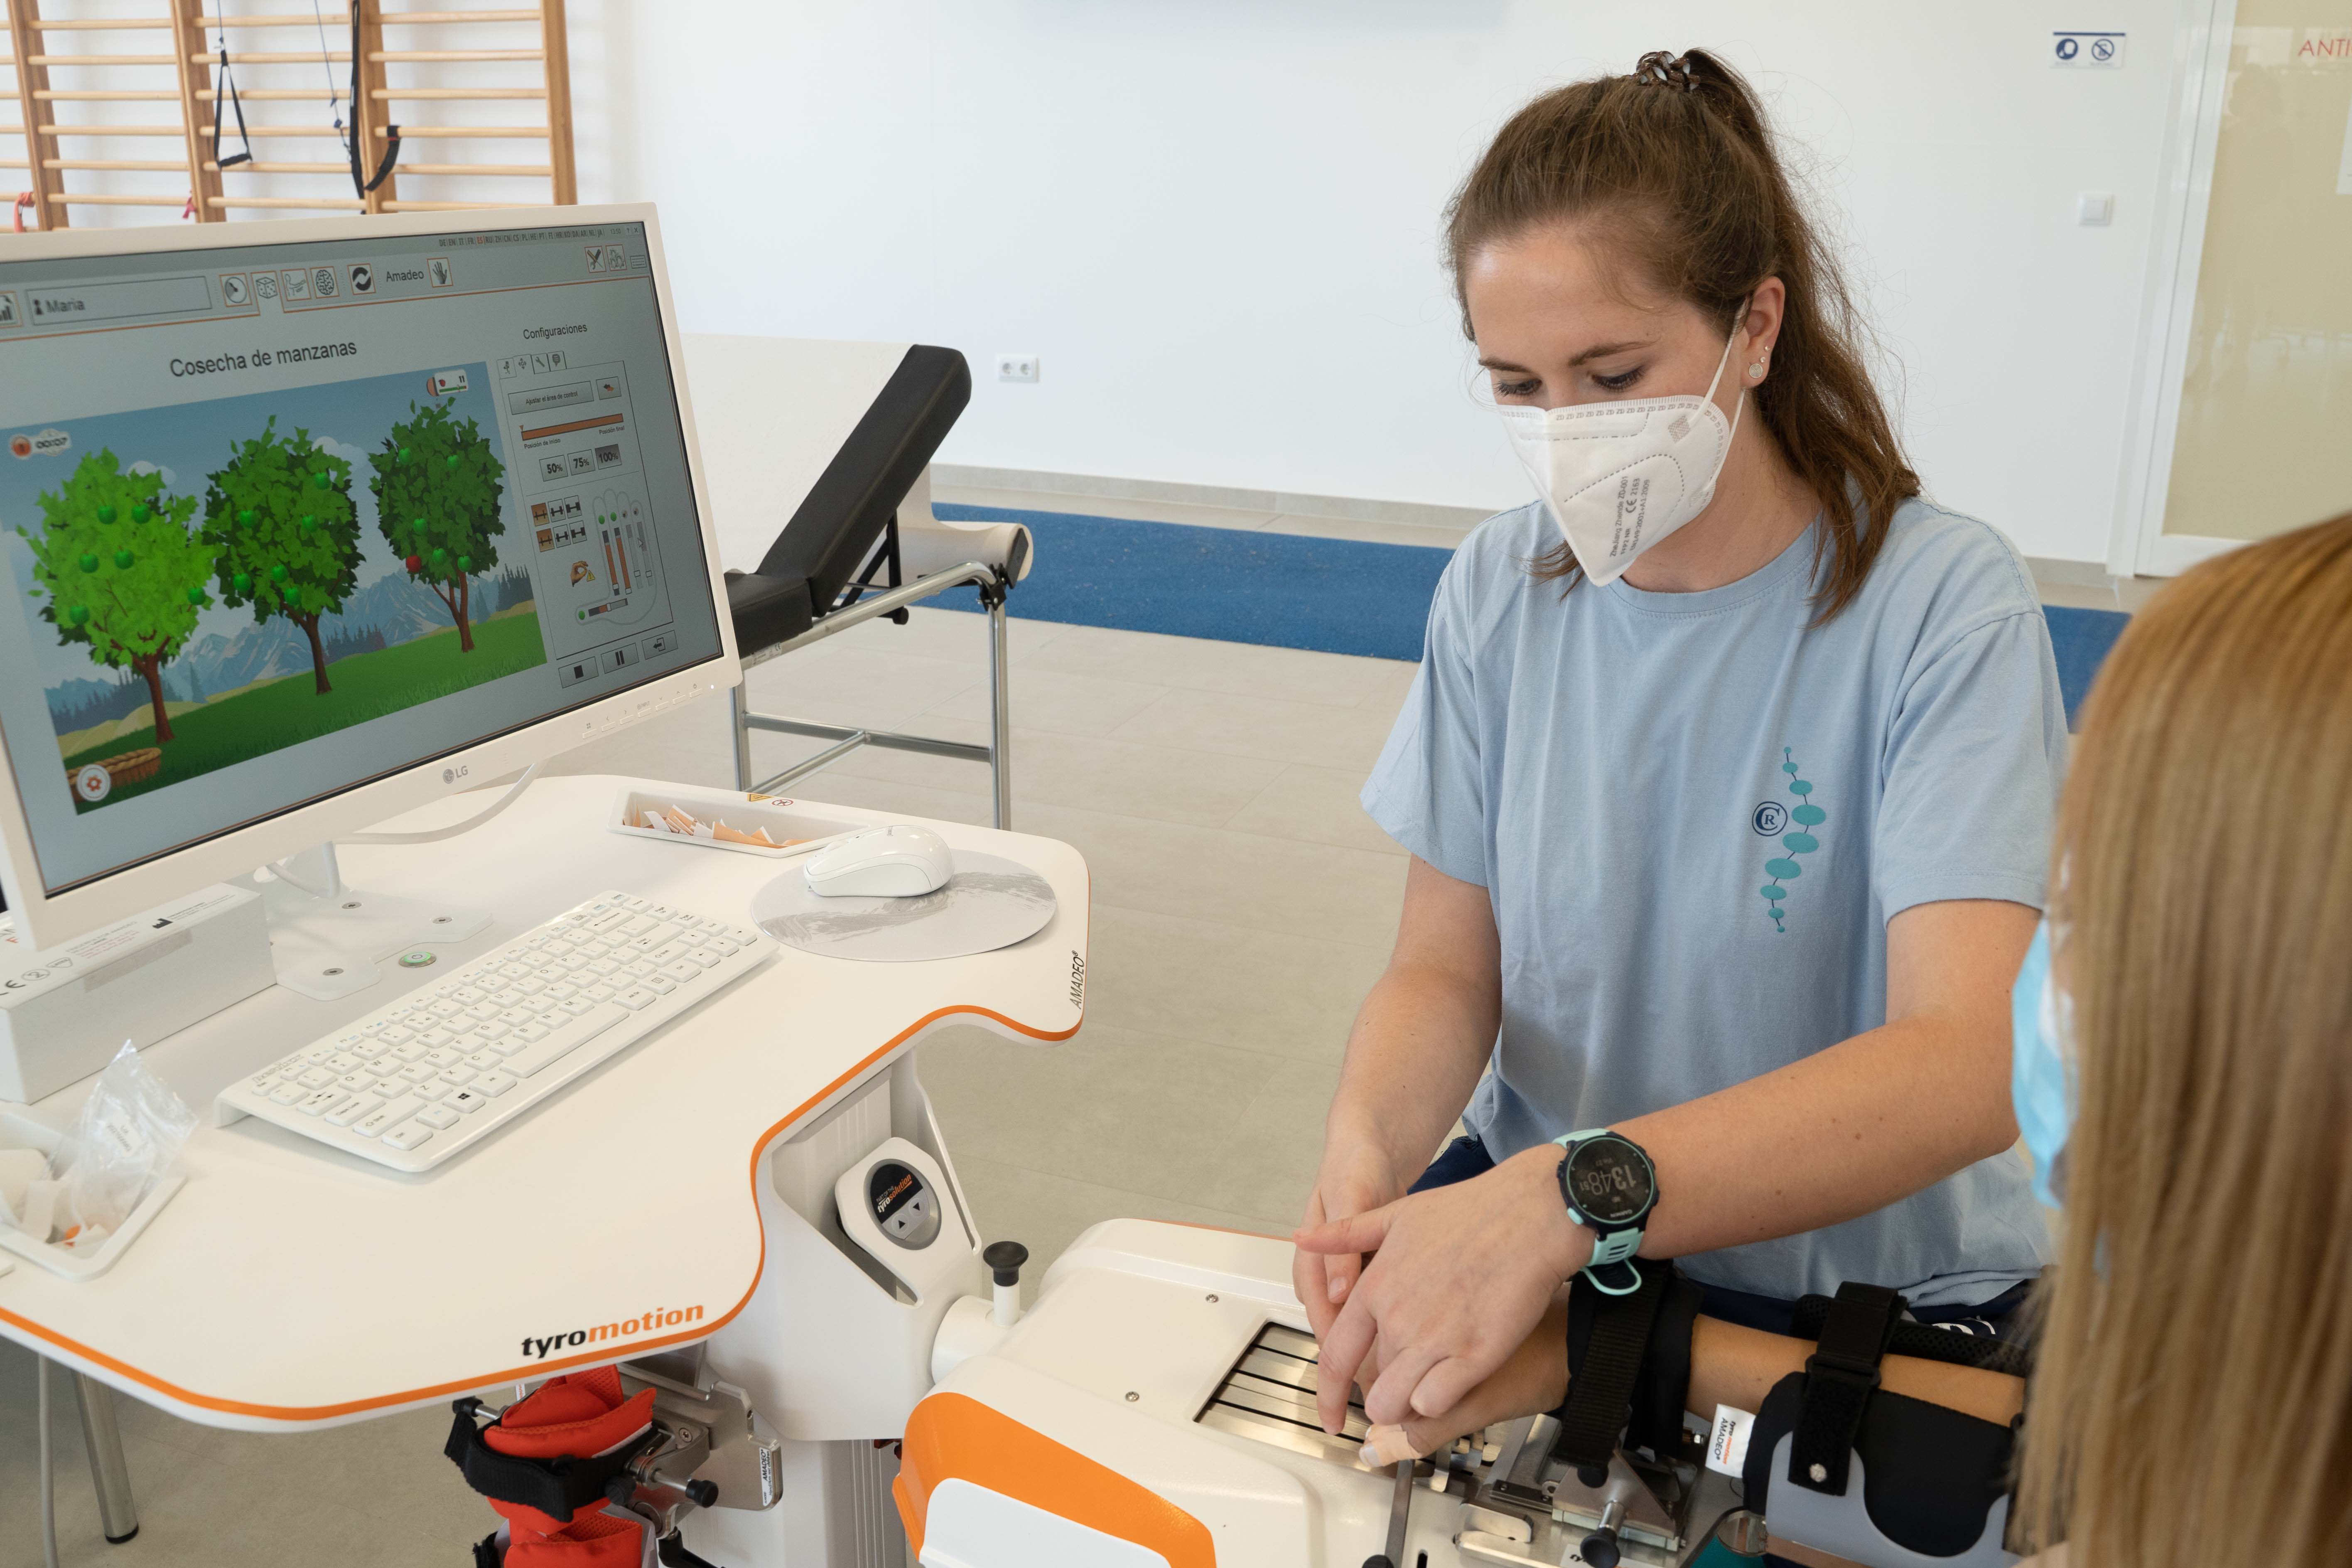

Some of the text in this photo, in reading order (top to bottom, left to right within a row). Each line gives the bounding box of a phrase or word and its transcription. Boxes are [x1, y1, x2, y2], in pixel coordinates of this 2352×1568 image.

[2297, 38, 2352, 56] ANTI
[439, 238, 447, 247] DE
[597, 229, 603, 238] JA
[386, 269, 424, 282] Amadeo
[523, 324, 587, 339] Configuraciones
[169, 341, 357, 377] Cosecha de manzanas
[459, 375, 465, 383] 11
[563, 390, 578, 399] control
[524, 441, 542, 449] Posición
[547, 452, 619, 474] 50% 75% 100%
[1618, 476, 1628, 499] ZD-001
[1630, 478, 1640, 496] 2163
[1625, 498, 1638, 513] CE
[1624, 528, 1631, 538] NR
[455, 765, 469, 778] LG
[877, 1174, 911, 1213] tyrosolution
[521, 1304, 704, 1358] tyromotion
